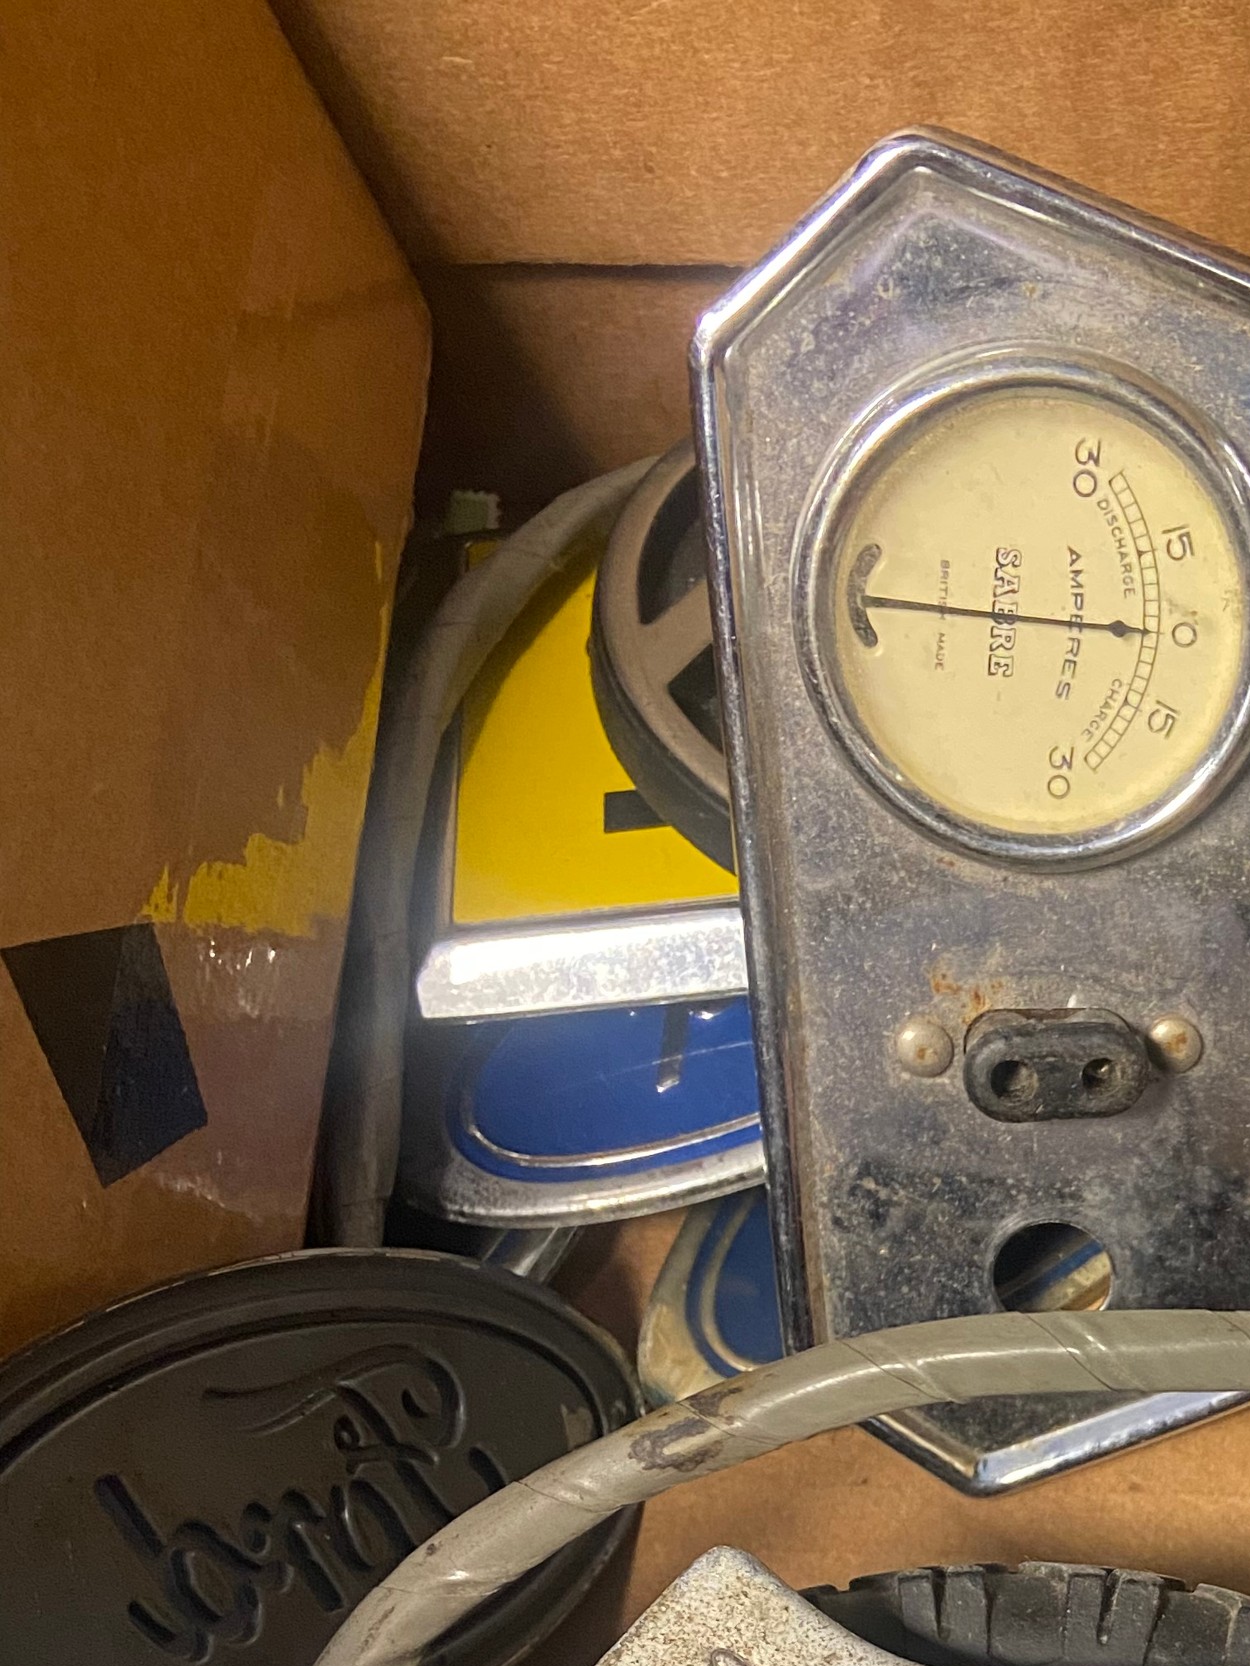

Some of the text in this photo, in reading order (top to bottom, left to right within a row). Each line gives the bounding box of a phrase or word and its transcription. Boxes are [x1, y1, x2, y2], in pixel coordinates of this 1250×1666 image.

[1074, 438, 1101, 499] 30
[1096, 499, 1137, 600] DISCHARGE
[1161, 524, 1194, 562] 15
[987, 546, 1023, 678] SABRE
[1054, 545, 1083, 702] AMPERES
[1171, 622, 1198, 648] 0
[933, 631, 946, 671] MADE
[1080, 677, 1123, 744] CHARGE
[1148, 700, 1181, 741] 15
[1046, 745, 1075, 801] 30
